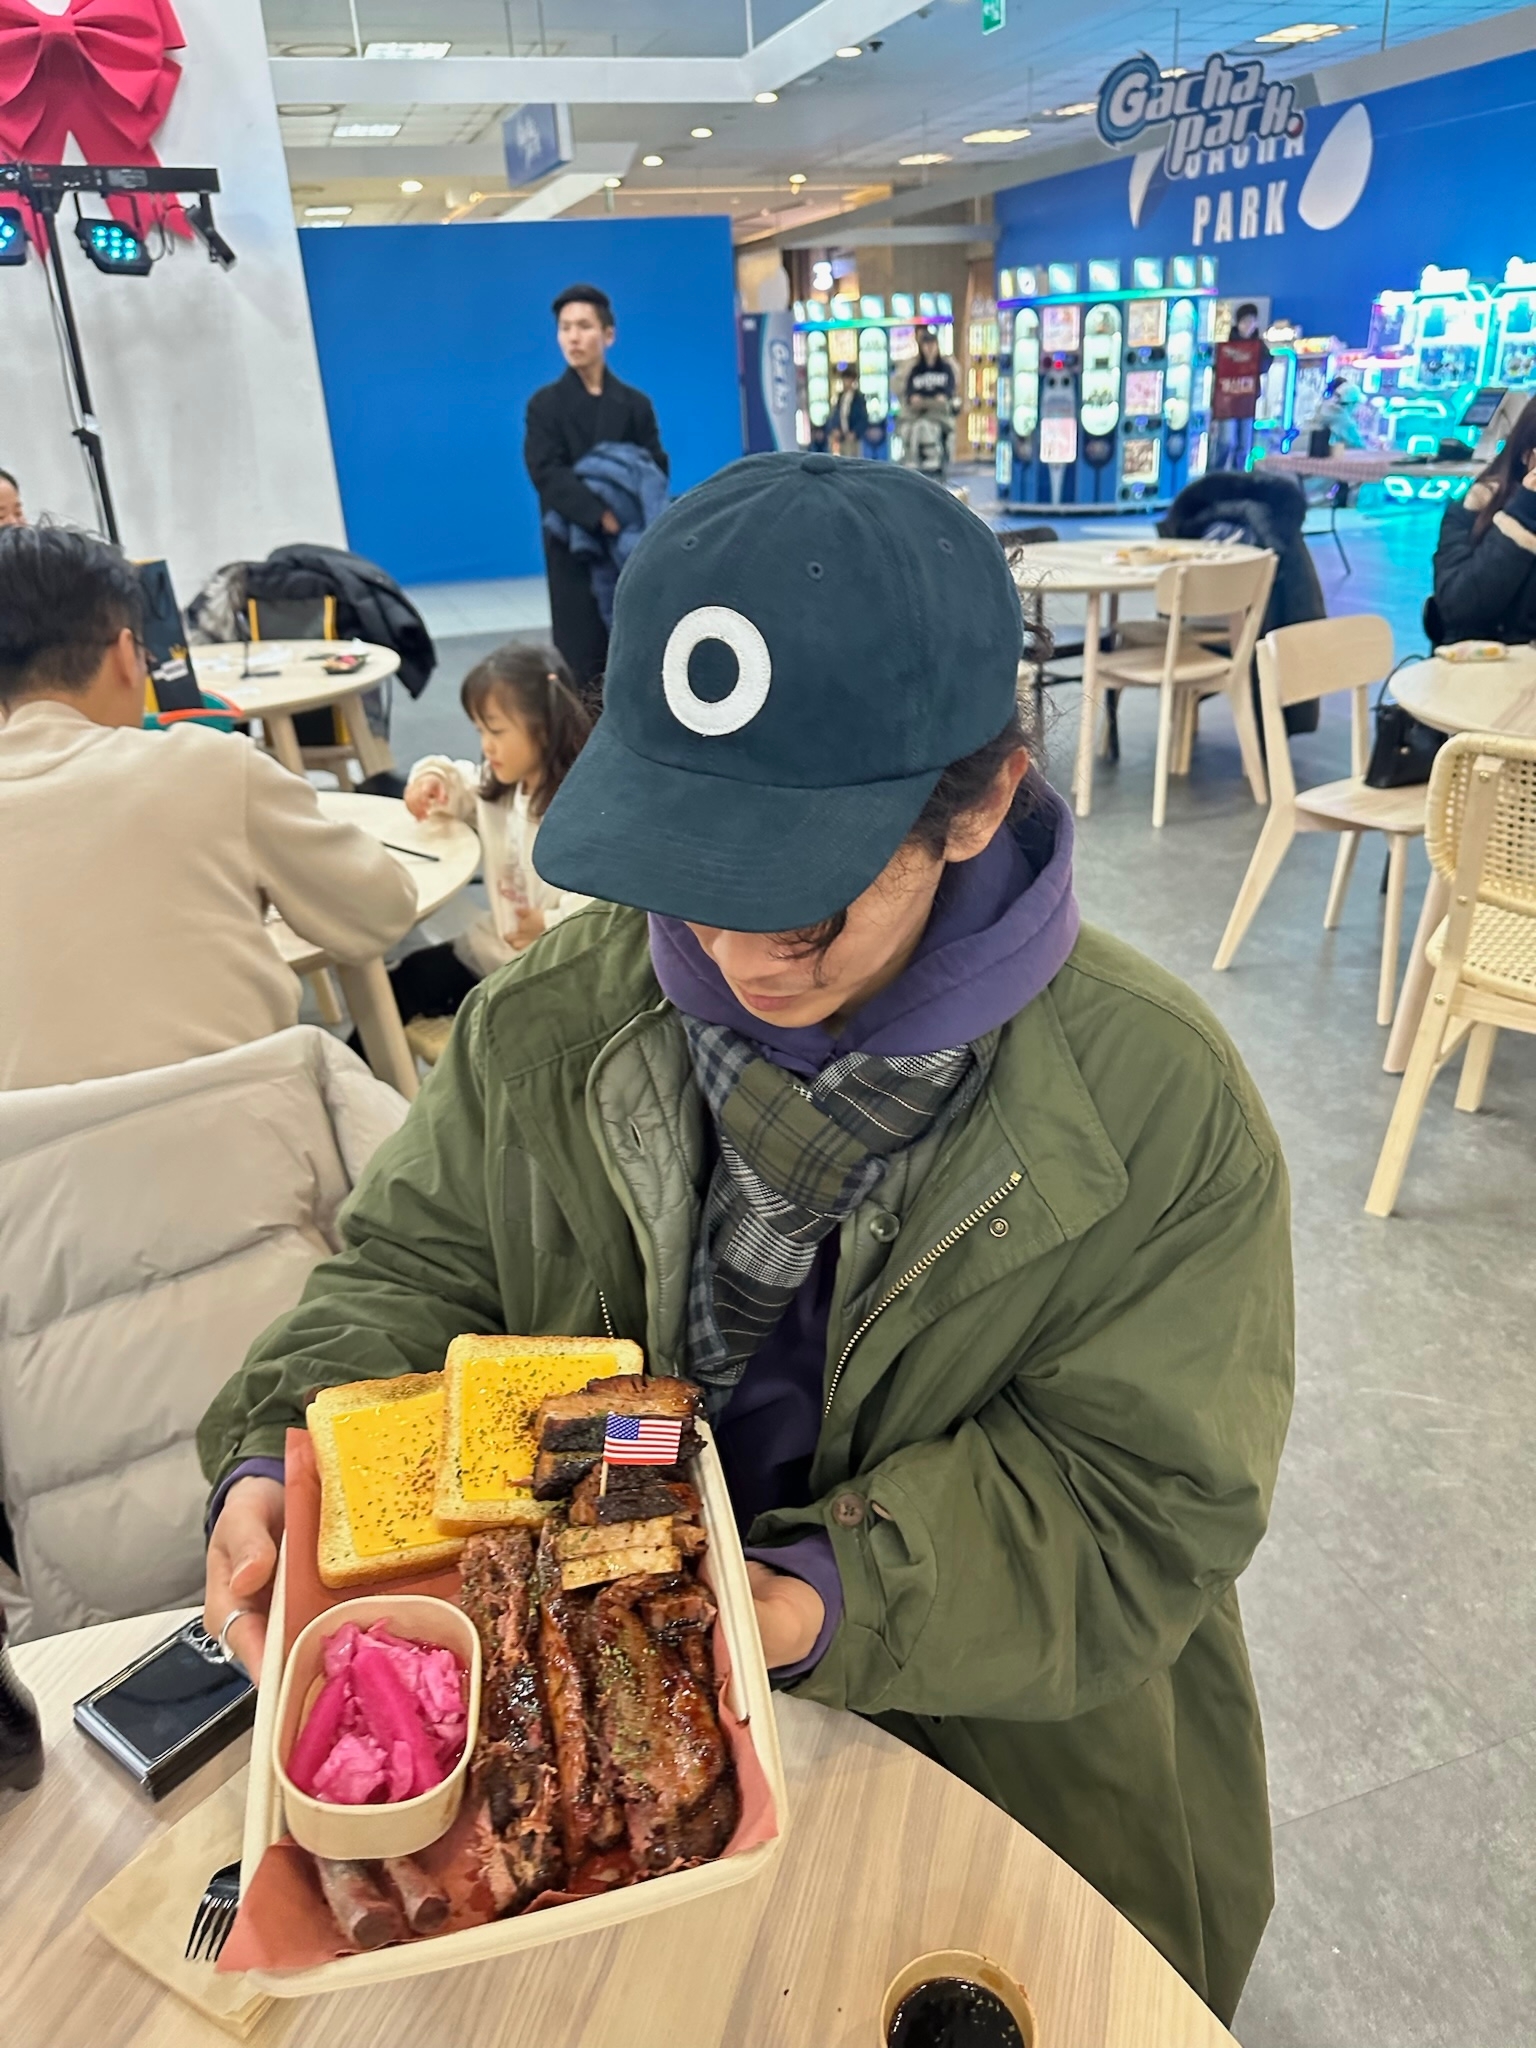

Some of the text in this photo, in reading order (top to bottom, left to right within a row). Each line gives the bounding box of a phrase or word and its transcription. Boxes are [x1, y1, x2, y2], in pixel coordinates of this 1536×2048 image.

[1103, 54, 1263, 131] Gacha
[1193, 181, 1287, 246] PARK
[662, 606, 772, 736] O
